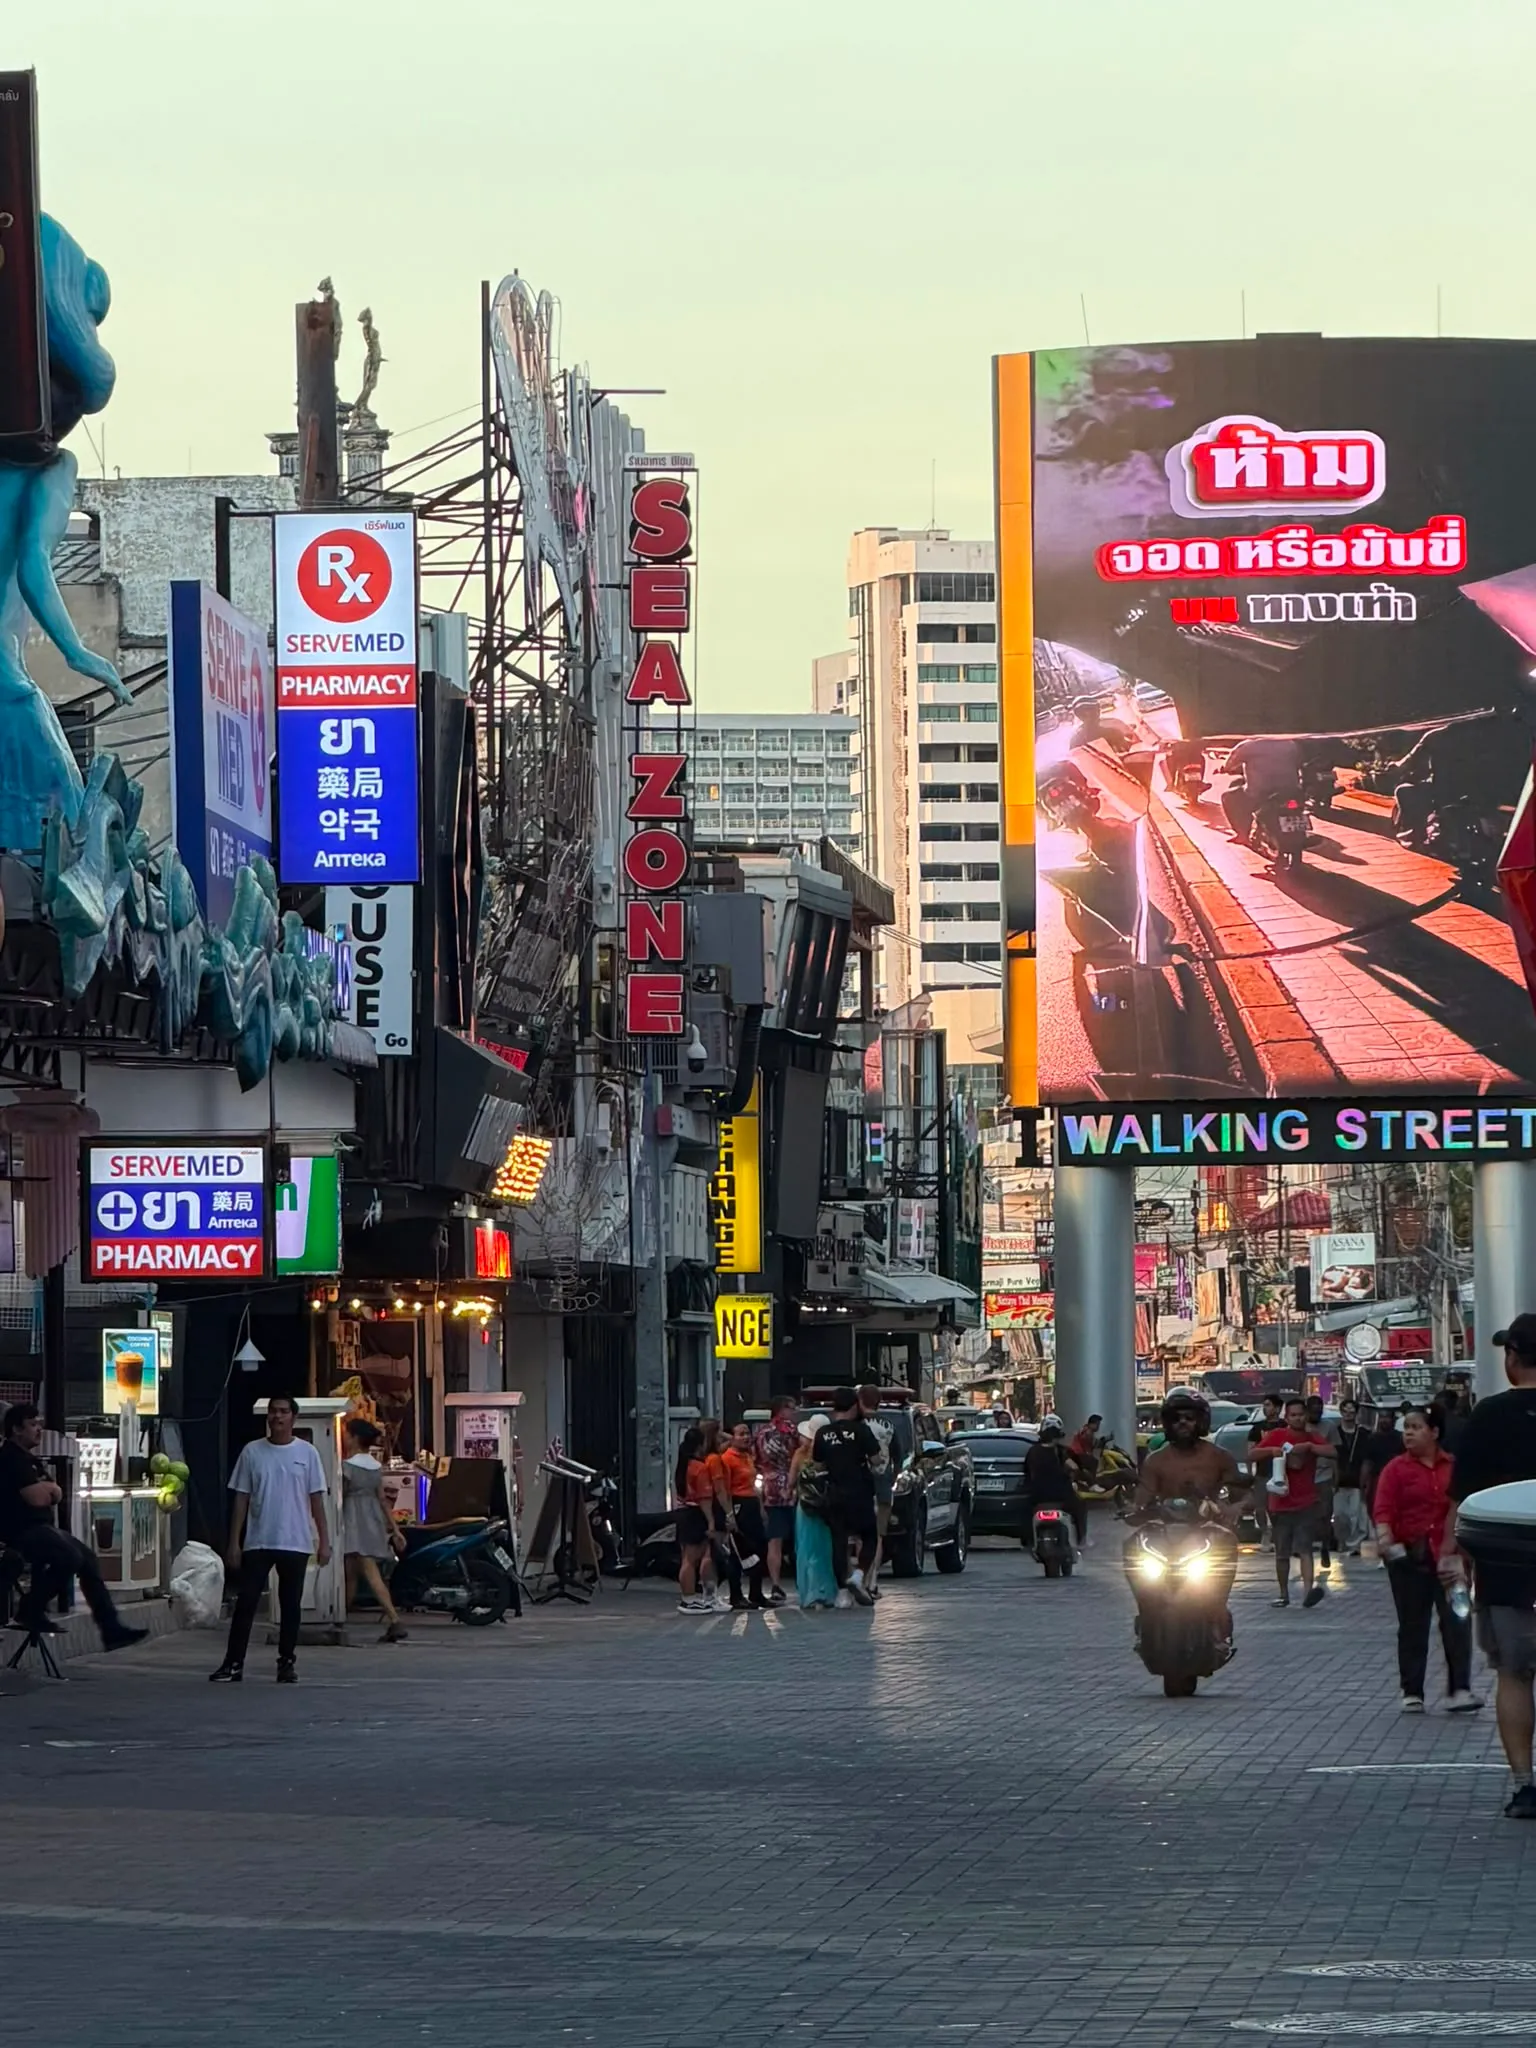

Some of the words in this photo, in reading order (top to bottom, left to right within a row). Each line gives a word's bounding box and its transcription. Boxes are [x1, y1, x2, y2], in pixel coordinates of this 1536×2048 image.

[1210, 429, 1369, 490] ห้าม
[1112, 541, 1221, 574] จอด
[1231, 519, 1461, 570] หรือขับขี่
[317, 545, 373, 604] Rx
[626, 477, 692, 706] SEA
[1248, 583, 1418, 623] ทางเท้า
[286, 632, 406, 654] SERVEMED
[206, 606, 248, 718] SERVE
[281, 673, 412, 697] PHARMACY
[319, 717, 376, 757] ยา
[216, 710, 246, 811] MED
[317, 767, 384, 800] 藥局
[318, 807, 382, 842] 약국
[314, 850, 387, 869] Аптека
[625, 752, 689, 1038] ZONE
[384, 1032, 408, 1048] Go
[1063, 1108, 1310, 1155] WALKING
[1335, 1108, 1536, 1153] STREET
[110, 1154, 244, 1177] SERVEMED
[142, 1190, 201, 1231] ยา
[212, 1191, 253, 1212] 藥局
[208, 1216, 258, 1230] Аптека
[96, 1244, 257, 1270] PHARMACY
[1331, 1236, 1366, 1247] ASANA
[1007, 1277, 1023, 1287] Pure
[1386, 1369, 1431, 1378] BOSS
[1388, 1377, 1432, 1387] CLUB
